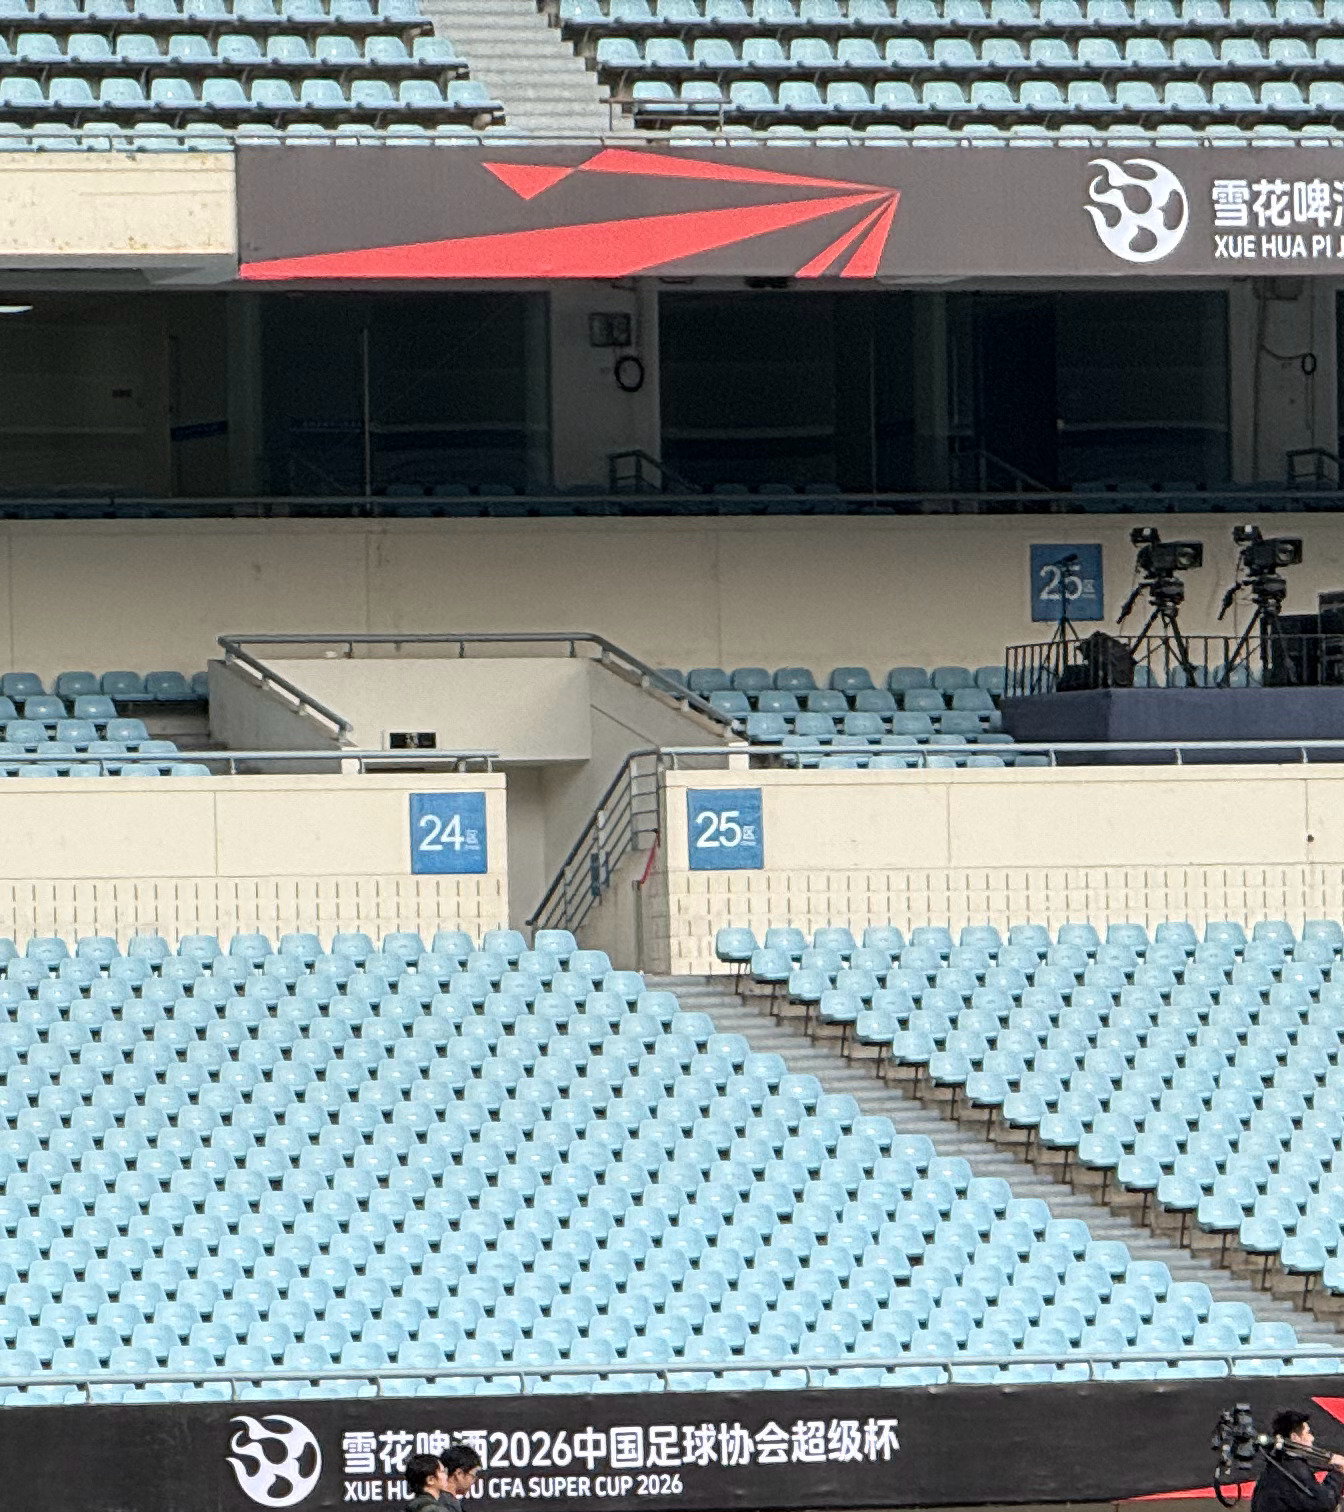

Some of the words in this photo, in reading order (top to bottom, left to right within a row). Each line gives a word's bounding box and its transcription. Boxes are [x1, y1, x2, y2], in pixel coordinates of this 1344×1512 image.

[1214, 234, 1256, 259] XUE
[1261, 234, 1308, 259] HUA
[1312, 234, 1332, 258] PI
[344, 1480, 383, 1502] XUE
[387, 1480, 416, 1501] HU
[488, 1477, 526, 1499] CFA
[528, 1476, 591, 1498] SUPER
[595, 1475, 634, 1497] CUP
[637, 1473, 684, 1495] 2026
